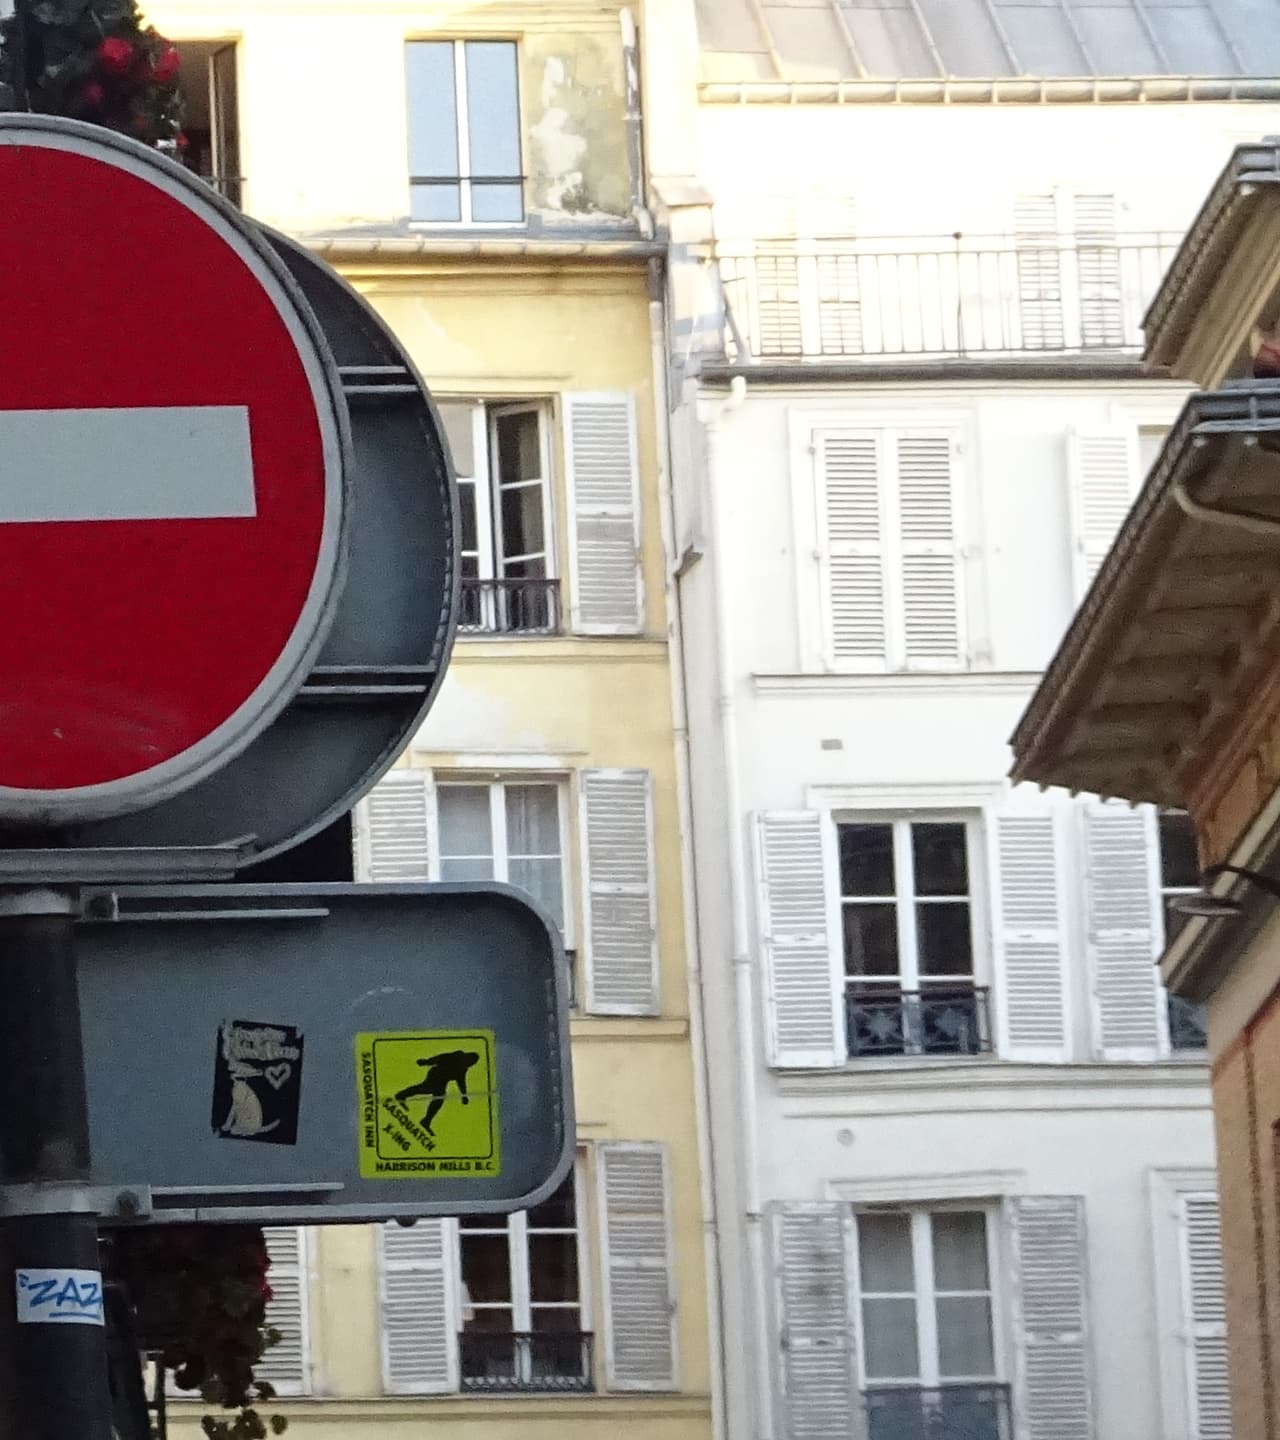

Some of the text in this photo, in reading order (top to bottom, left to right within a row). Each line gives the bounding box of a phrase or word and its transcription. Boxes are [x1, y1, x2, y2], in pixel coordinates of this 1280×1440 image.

[361, 1051, 376, 1148] SASQUATCH INN
[382, 1097, 438, 1153] SASQUATCH
[375, 1161, 436, 1172] HARRISON
[438, 1161, 472, 1172] MILLS
